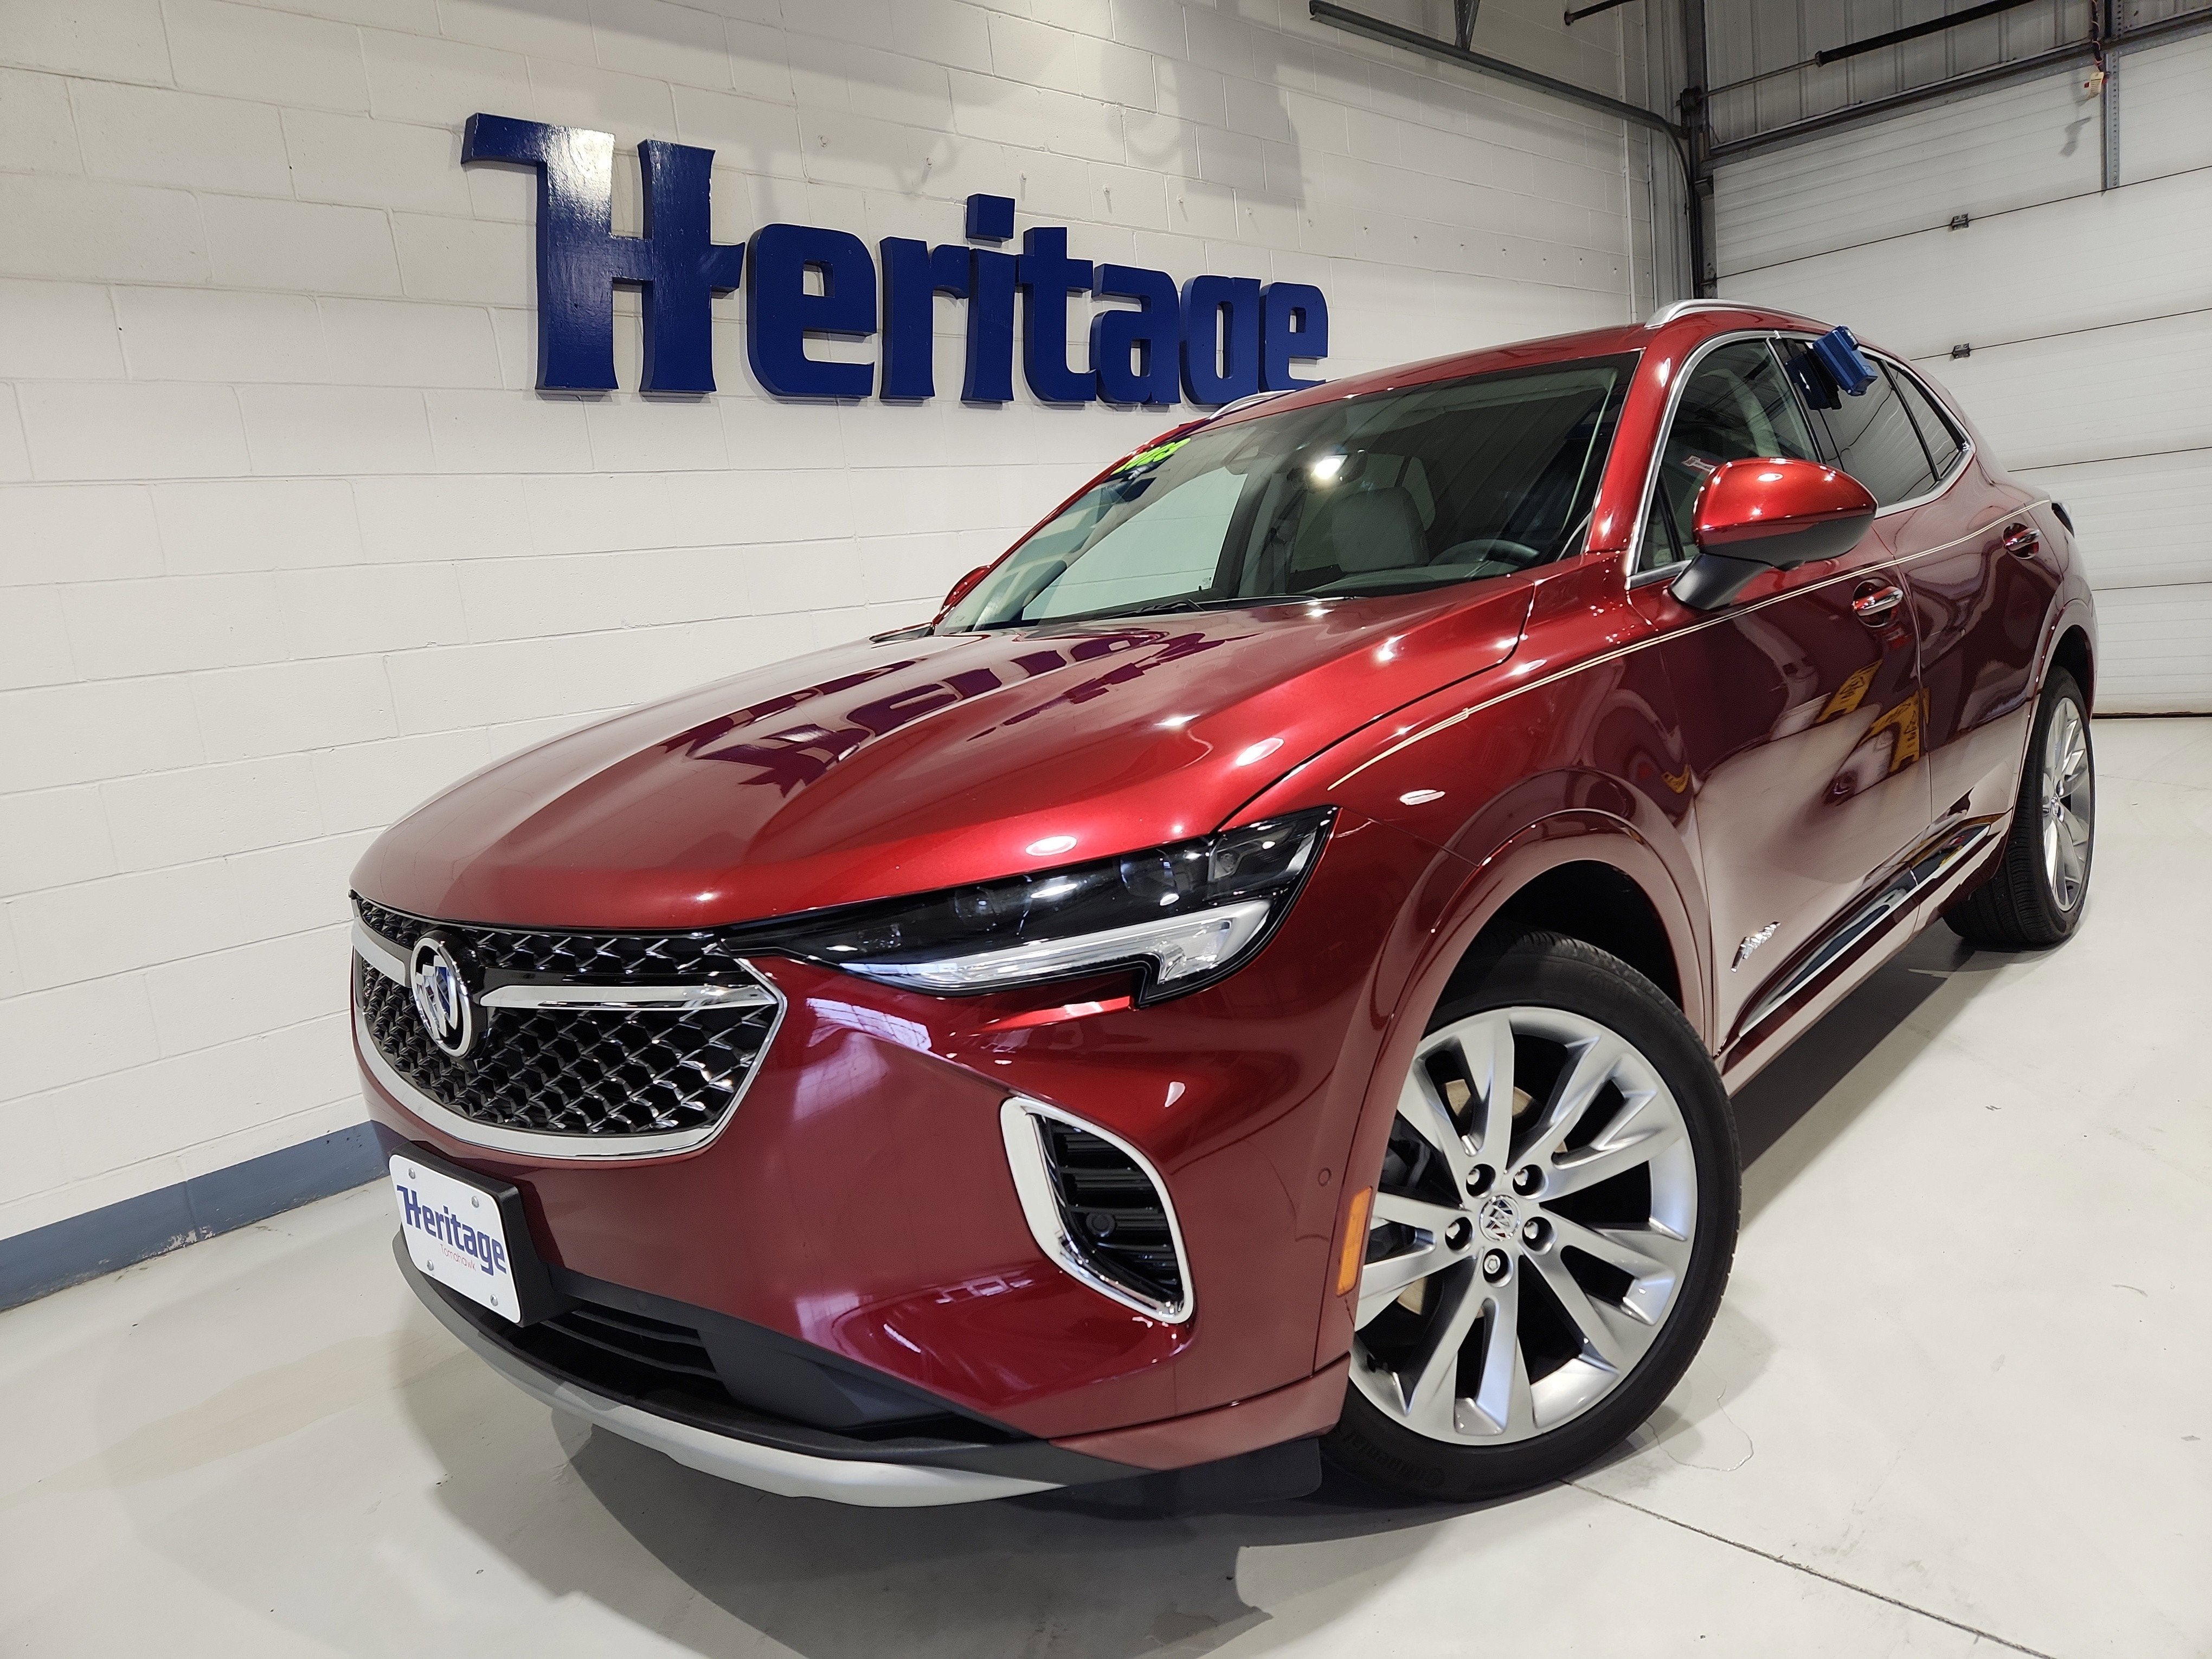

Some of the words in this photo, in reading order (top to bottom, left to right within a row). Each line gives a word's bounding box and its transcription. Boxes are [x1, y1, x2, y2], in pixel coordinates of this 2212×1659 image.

[461, 112, 1329, 406] Heritage
[396, 1184, 507, 1276] Heritage
[440, 1244, 476, 1271] Tomahawk
